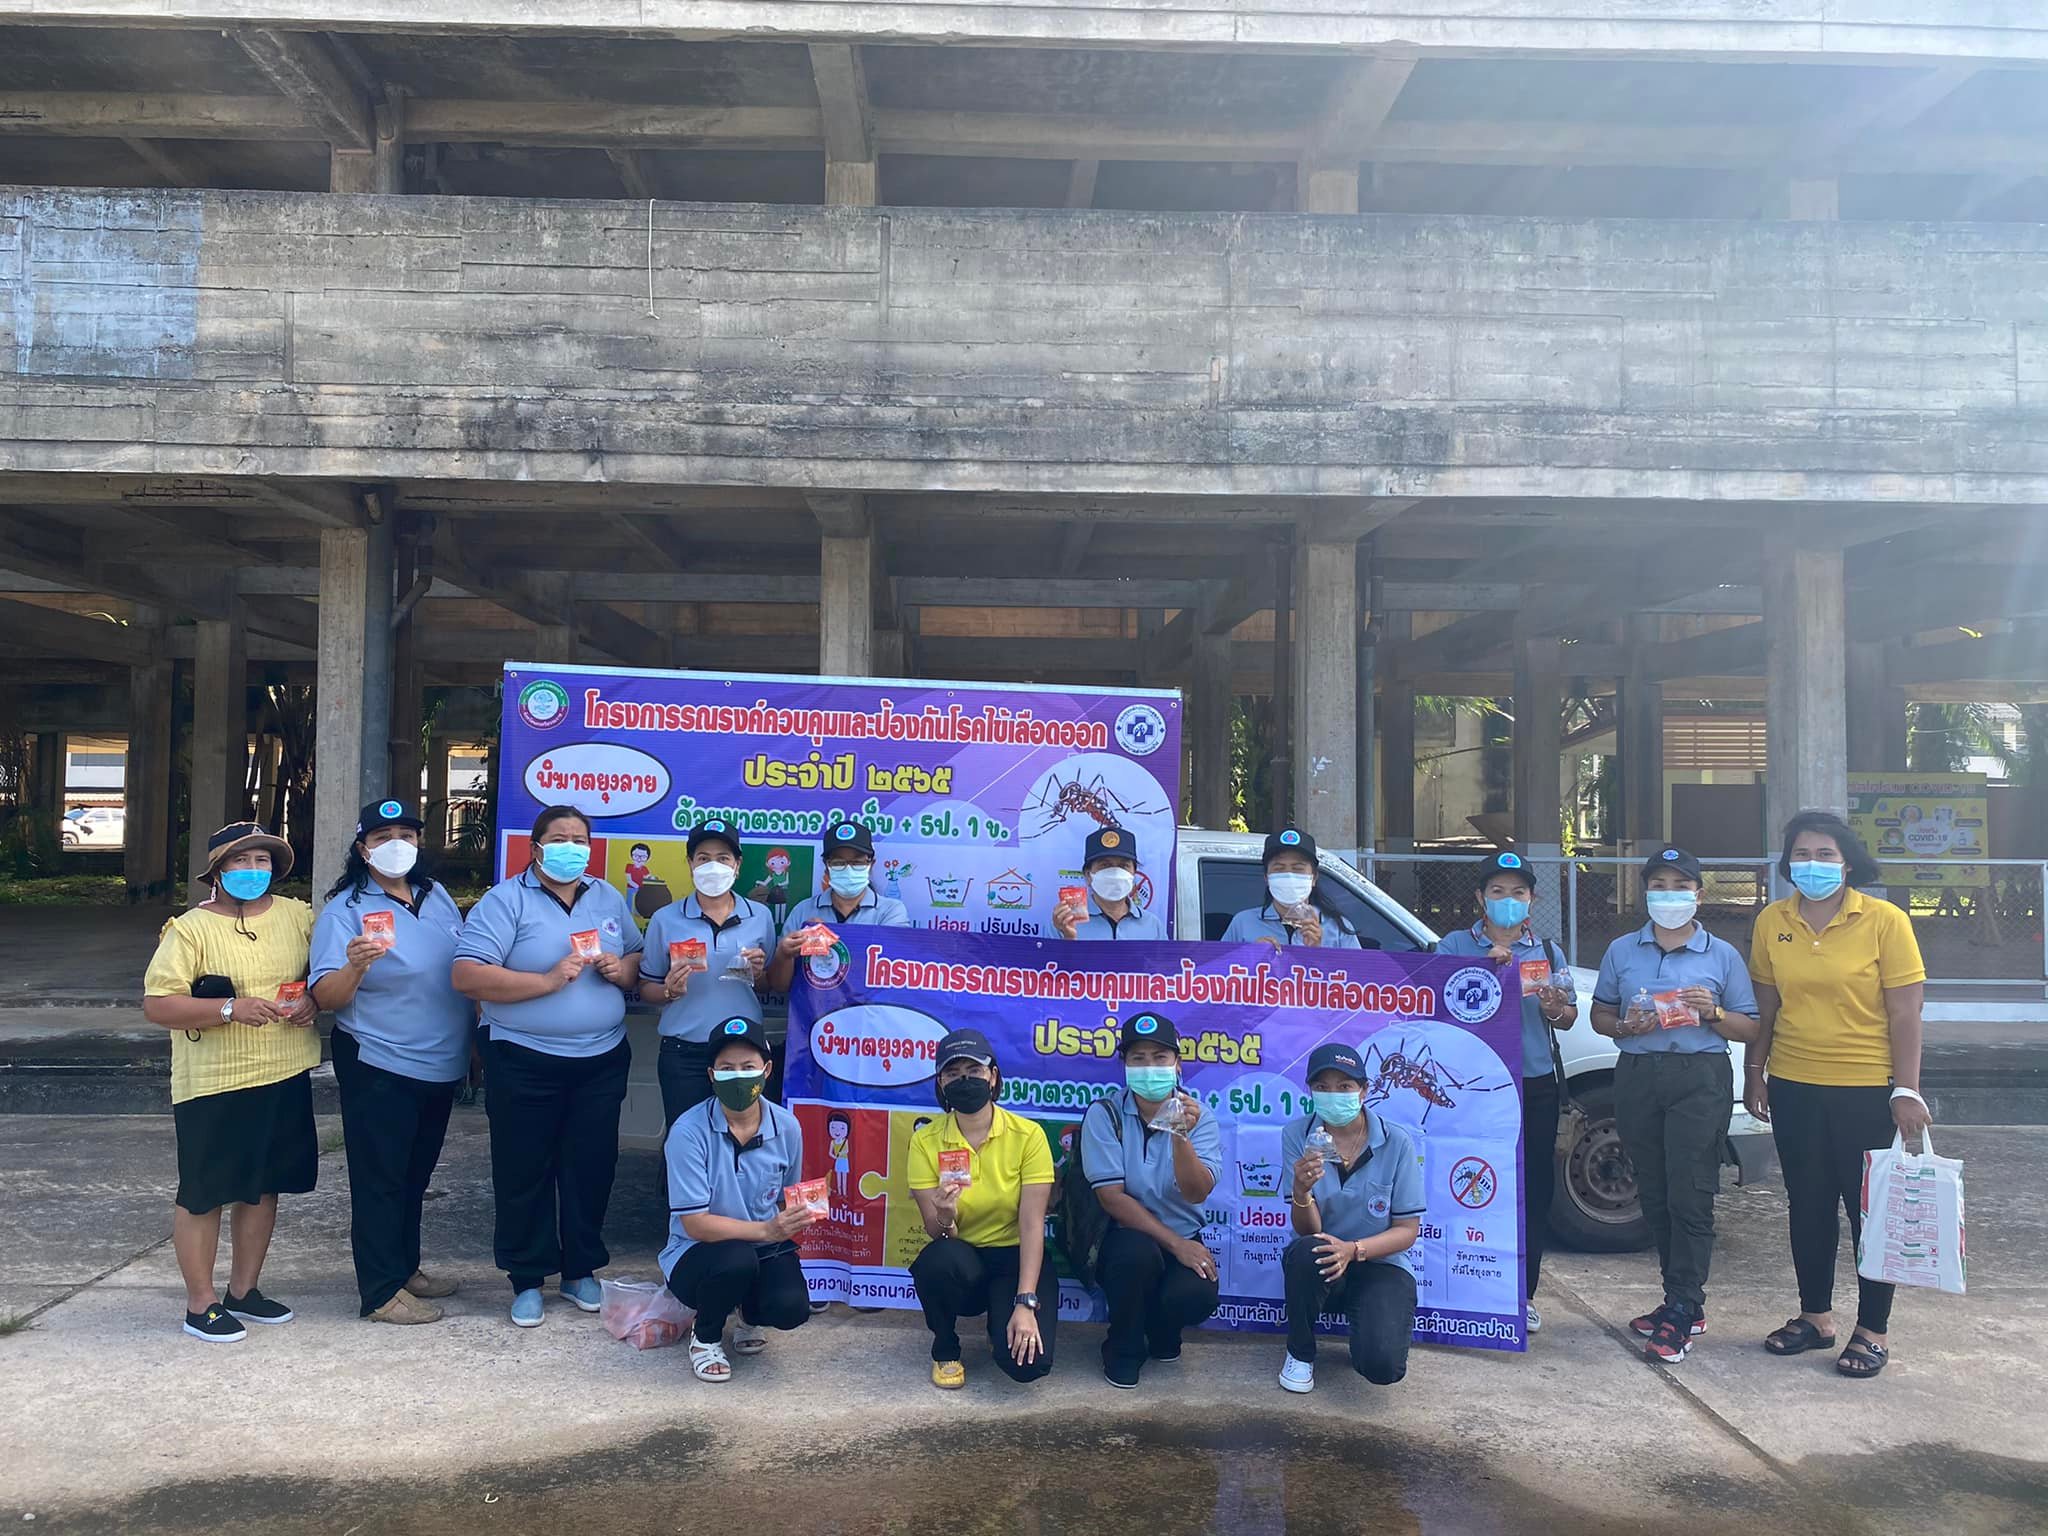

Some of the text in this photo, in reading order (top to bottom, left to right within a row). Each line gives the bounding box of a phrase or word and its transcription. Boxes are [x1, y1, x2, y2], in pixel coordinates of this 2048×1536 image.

[585, 689, 1107, 748] โครงการรณรงค์ควบคุมและป้องกันโรคไข้เลือดออก
[744, 752, 952, 794] ประจำปี ๒๕๖๕
[967, 816, 979, 838] 1
[981, 917, 1040, 936] ปรับปรง
[866, 945, 1435, 1017] โครงการรณรงค์ควบคุมและป้องกันโรคไข้เลือดออก
[1280, 1091, 1291, 1115] 1
[1240, 1206, 1286, 1227] ปล่อย
[1241, 1232, 1285, 1244] ปล่อยปลา
[1466, 1226, 1485, 1242] ขัด
[1243, 1247, 1282, 1265] กินลูกน้ำ
